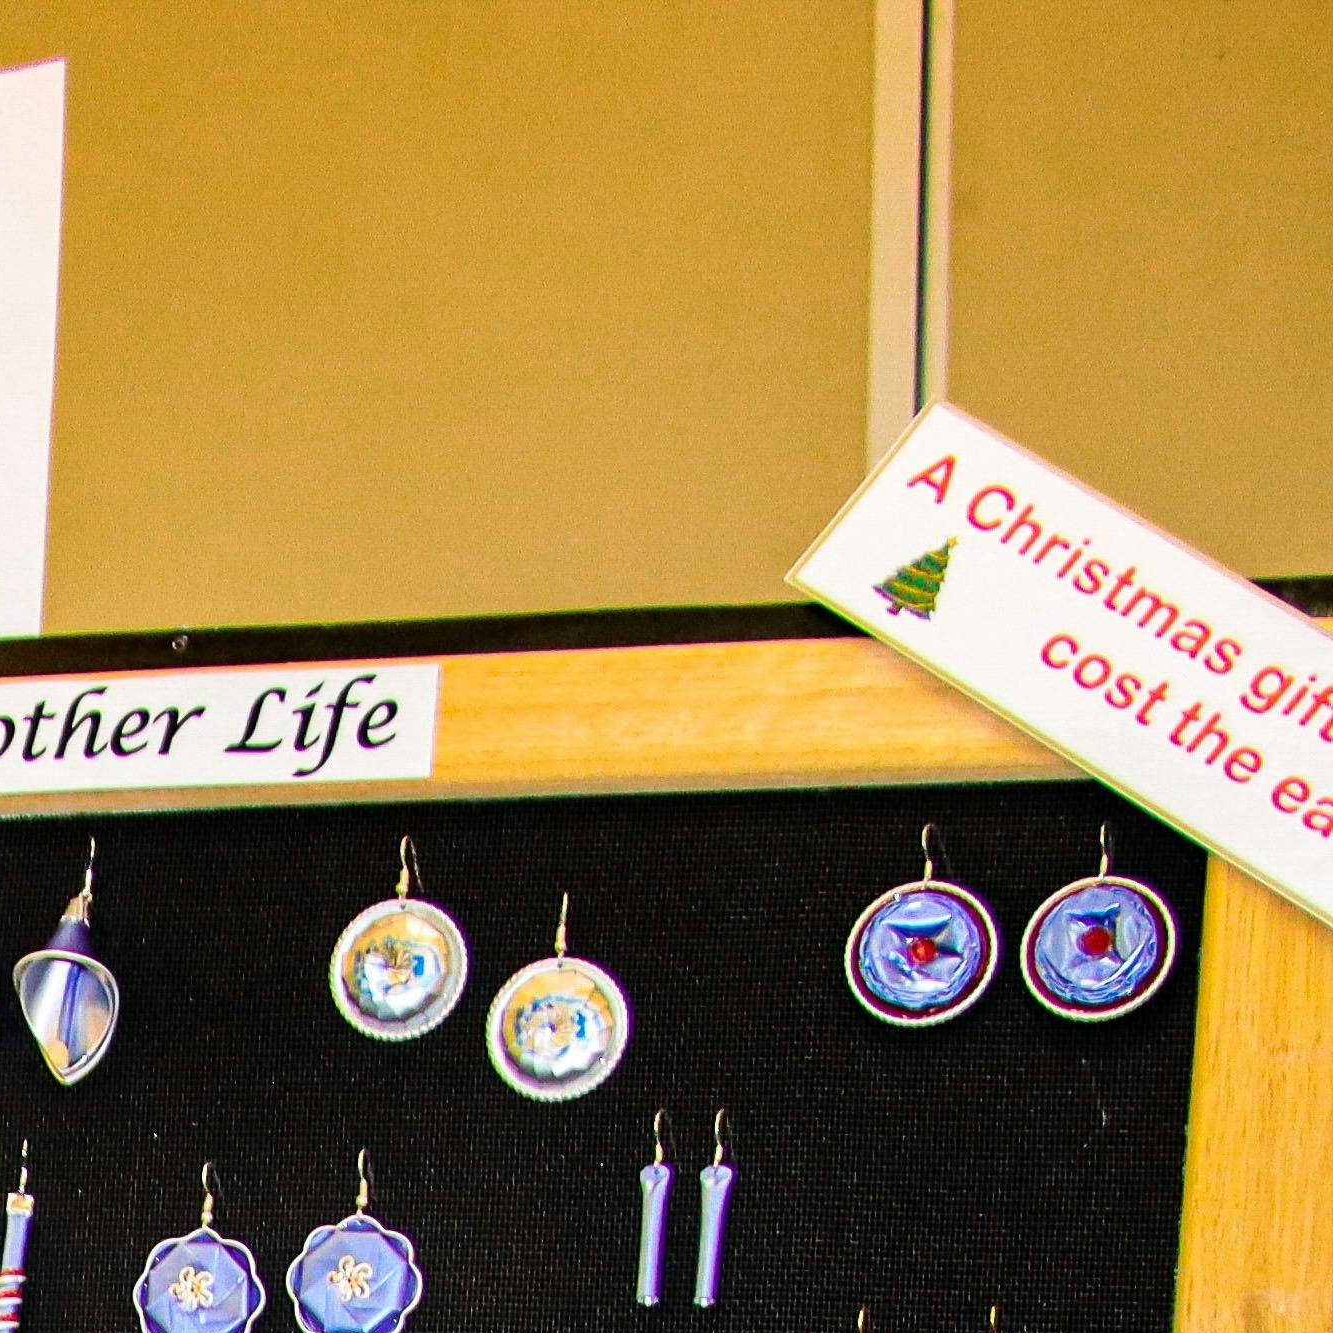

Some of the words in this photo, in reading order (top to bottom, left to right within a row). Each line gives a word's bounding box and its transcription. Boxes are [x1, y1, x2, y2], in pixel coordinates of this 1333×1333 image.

[907, 455, 955, 504] A
[967, 486, 1241, 674] Christmas
[225, 675, 398, 777] Life
[1041, 634, 1168, 726] cost
[1169, 704, 1263, 782] the
